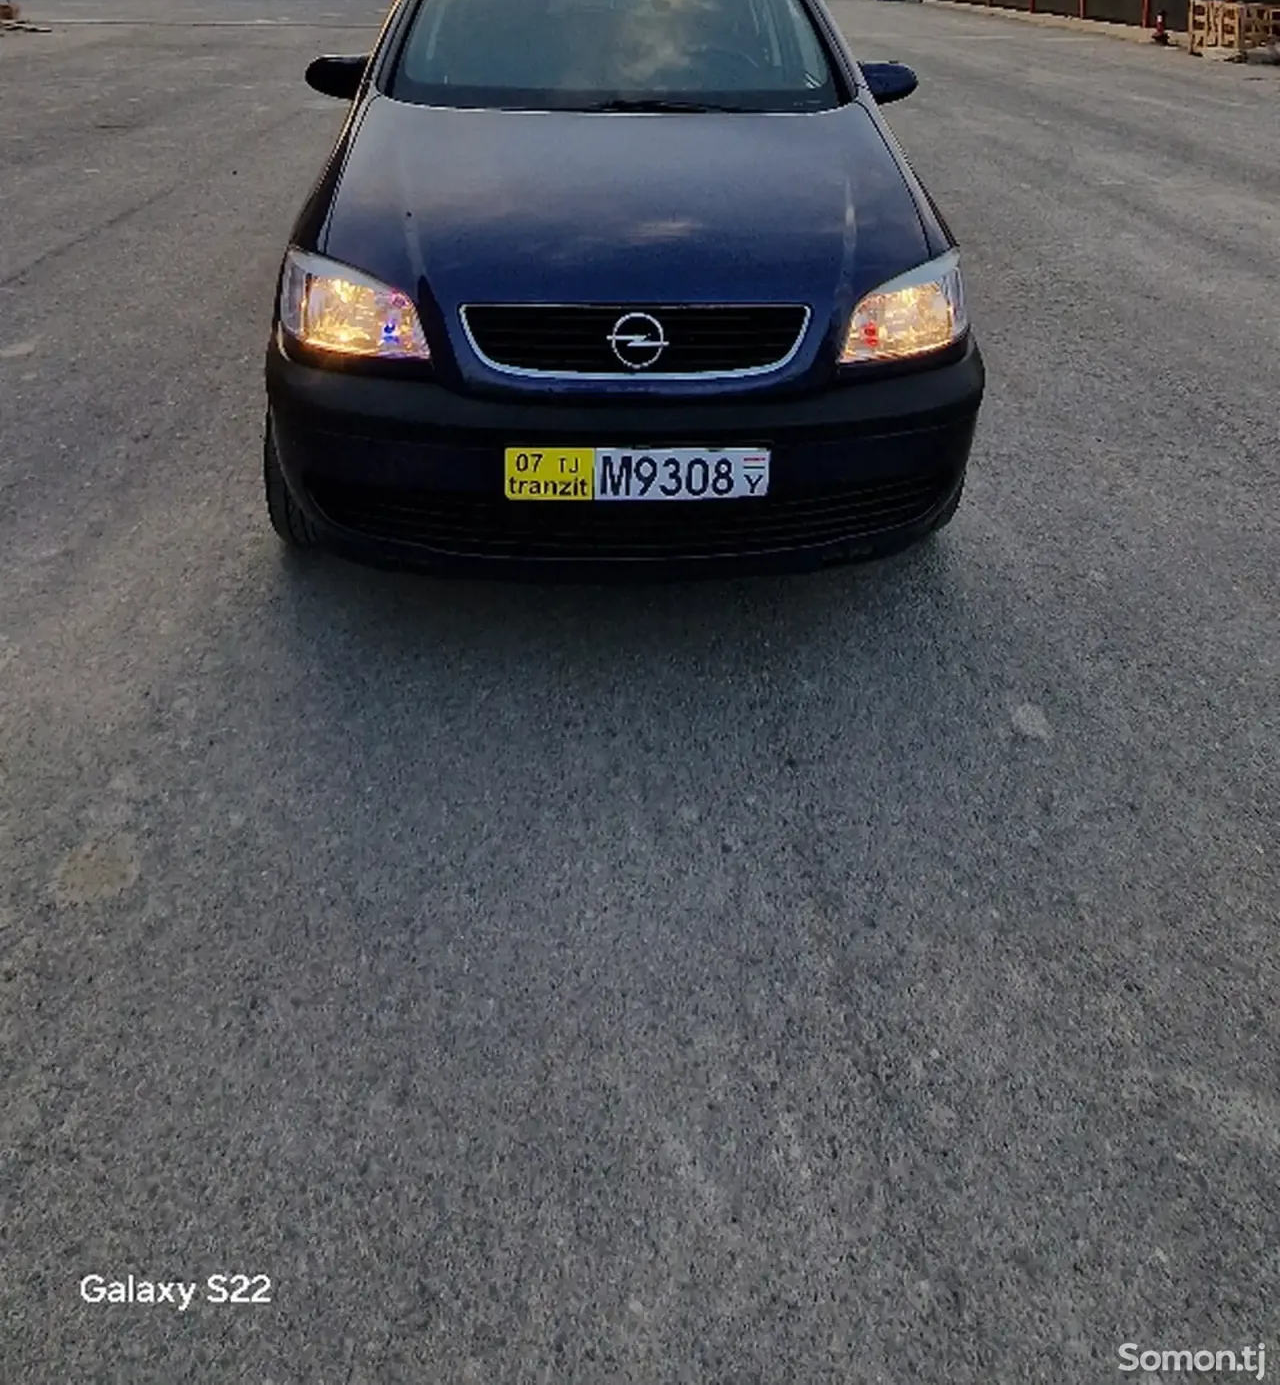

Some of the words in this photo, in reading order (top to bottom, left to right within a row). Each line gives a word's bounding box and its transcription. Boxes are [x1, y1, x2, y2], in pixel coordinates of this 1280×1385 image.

[515, 453, 543, 472] 07
[557, 457, 579, 474] TJ
[509, 476, 588, 496] tranzit
[600, 455, 734, 497] M9308
[744, 474, 764, 494] Y
